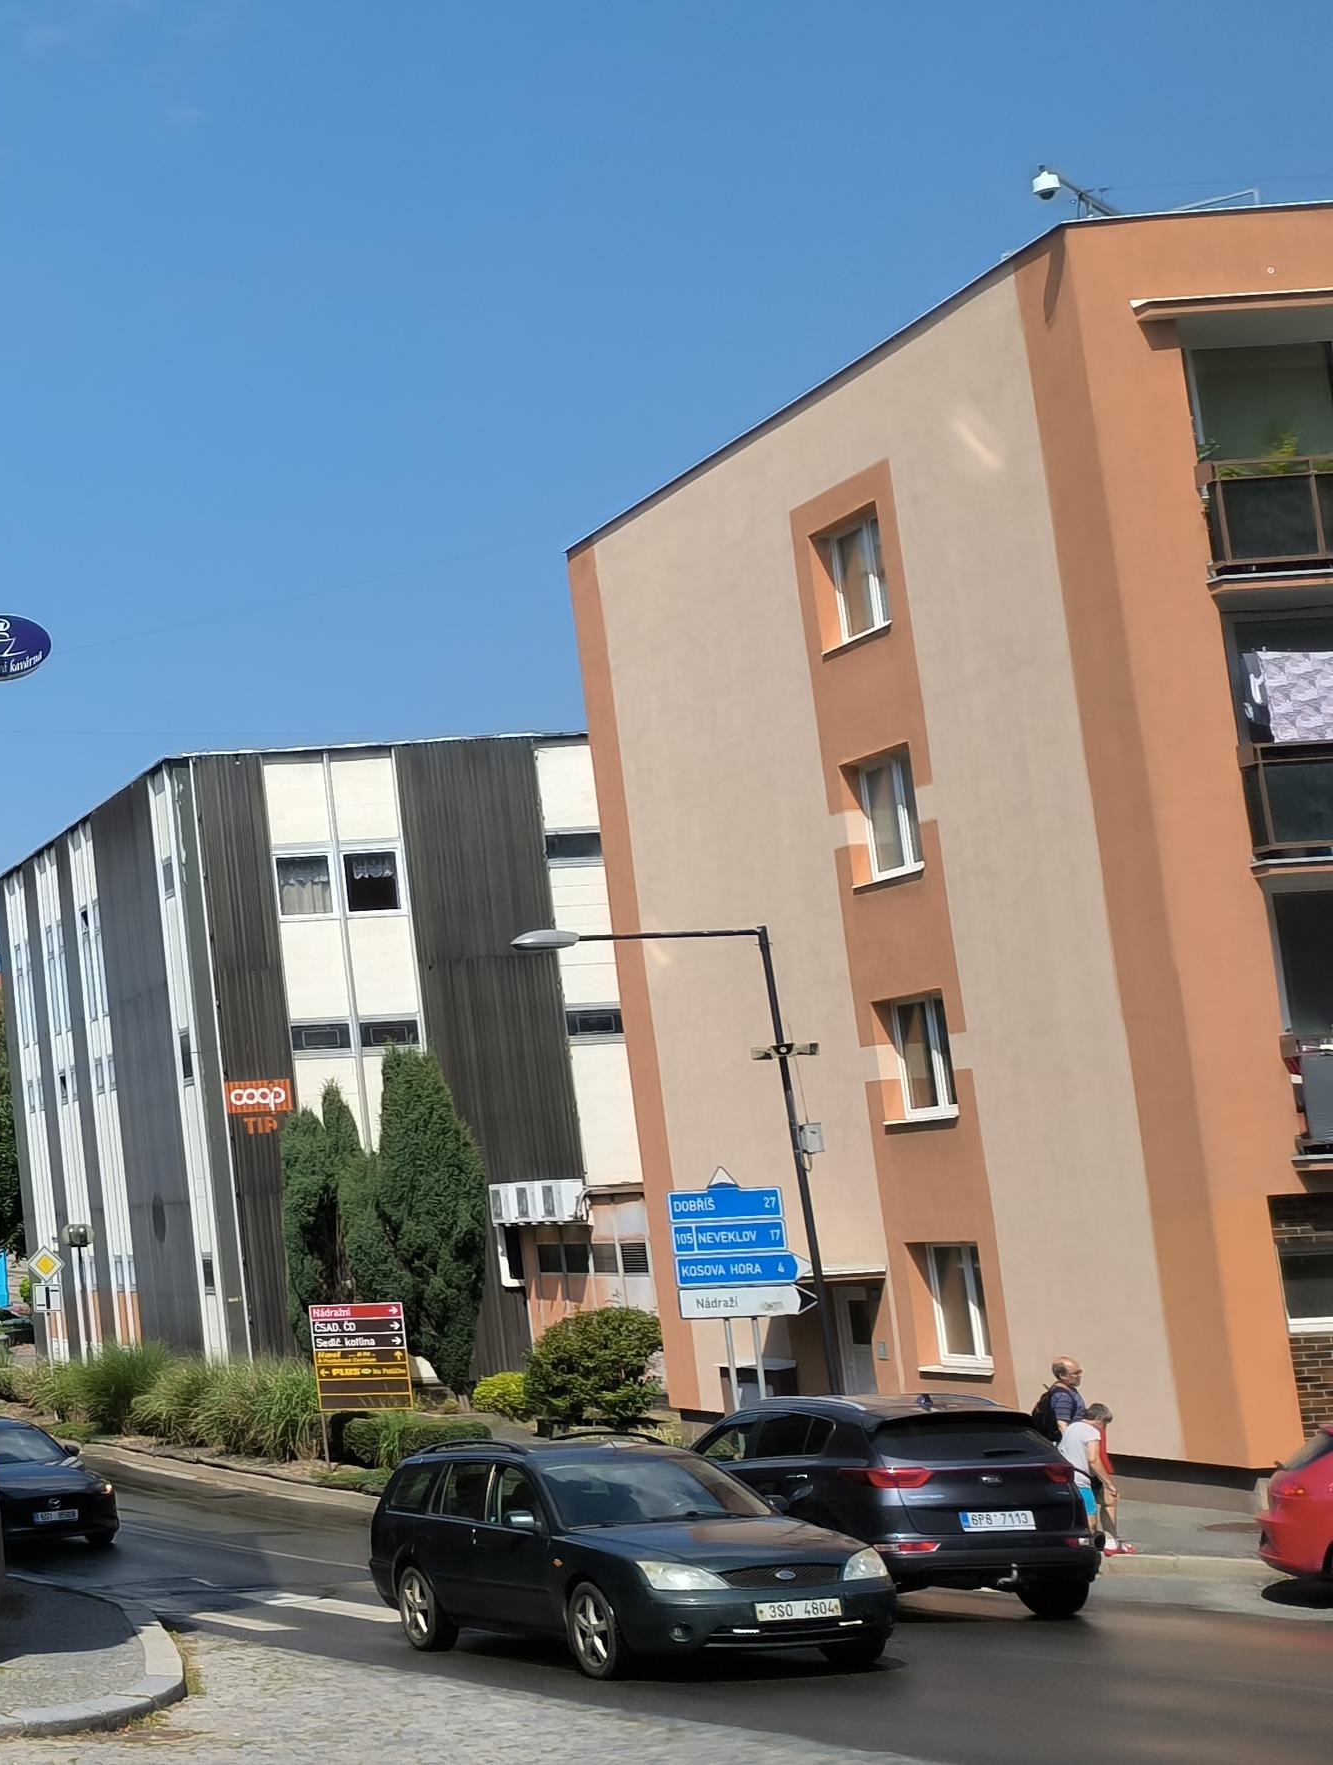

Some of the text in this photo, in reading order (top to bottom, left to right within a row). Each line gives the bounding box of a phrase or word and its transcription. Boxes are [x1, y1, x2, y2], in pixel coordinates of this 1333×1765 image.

[230, 1086, 286, 1112] coop
[243, 1117, 278, 1135] TIP
[673, 1196, 776, 1213] DOBŘÍŠ 27
[675, 1229, 781, 1245] 105 NEVEKLOV 17
[681, 1262, 785, 1278] KOSOVA HORA 4
[695, 1296, 738, 1309] Nádraží
[1000, 1513, 1029, 1525] 7113
